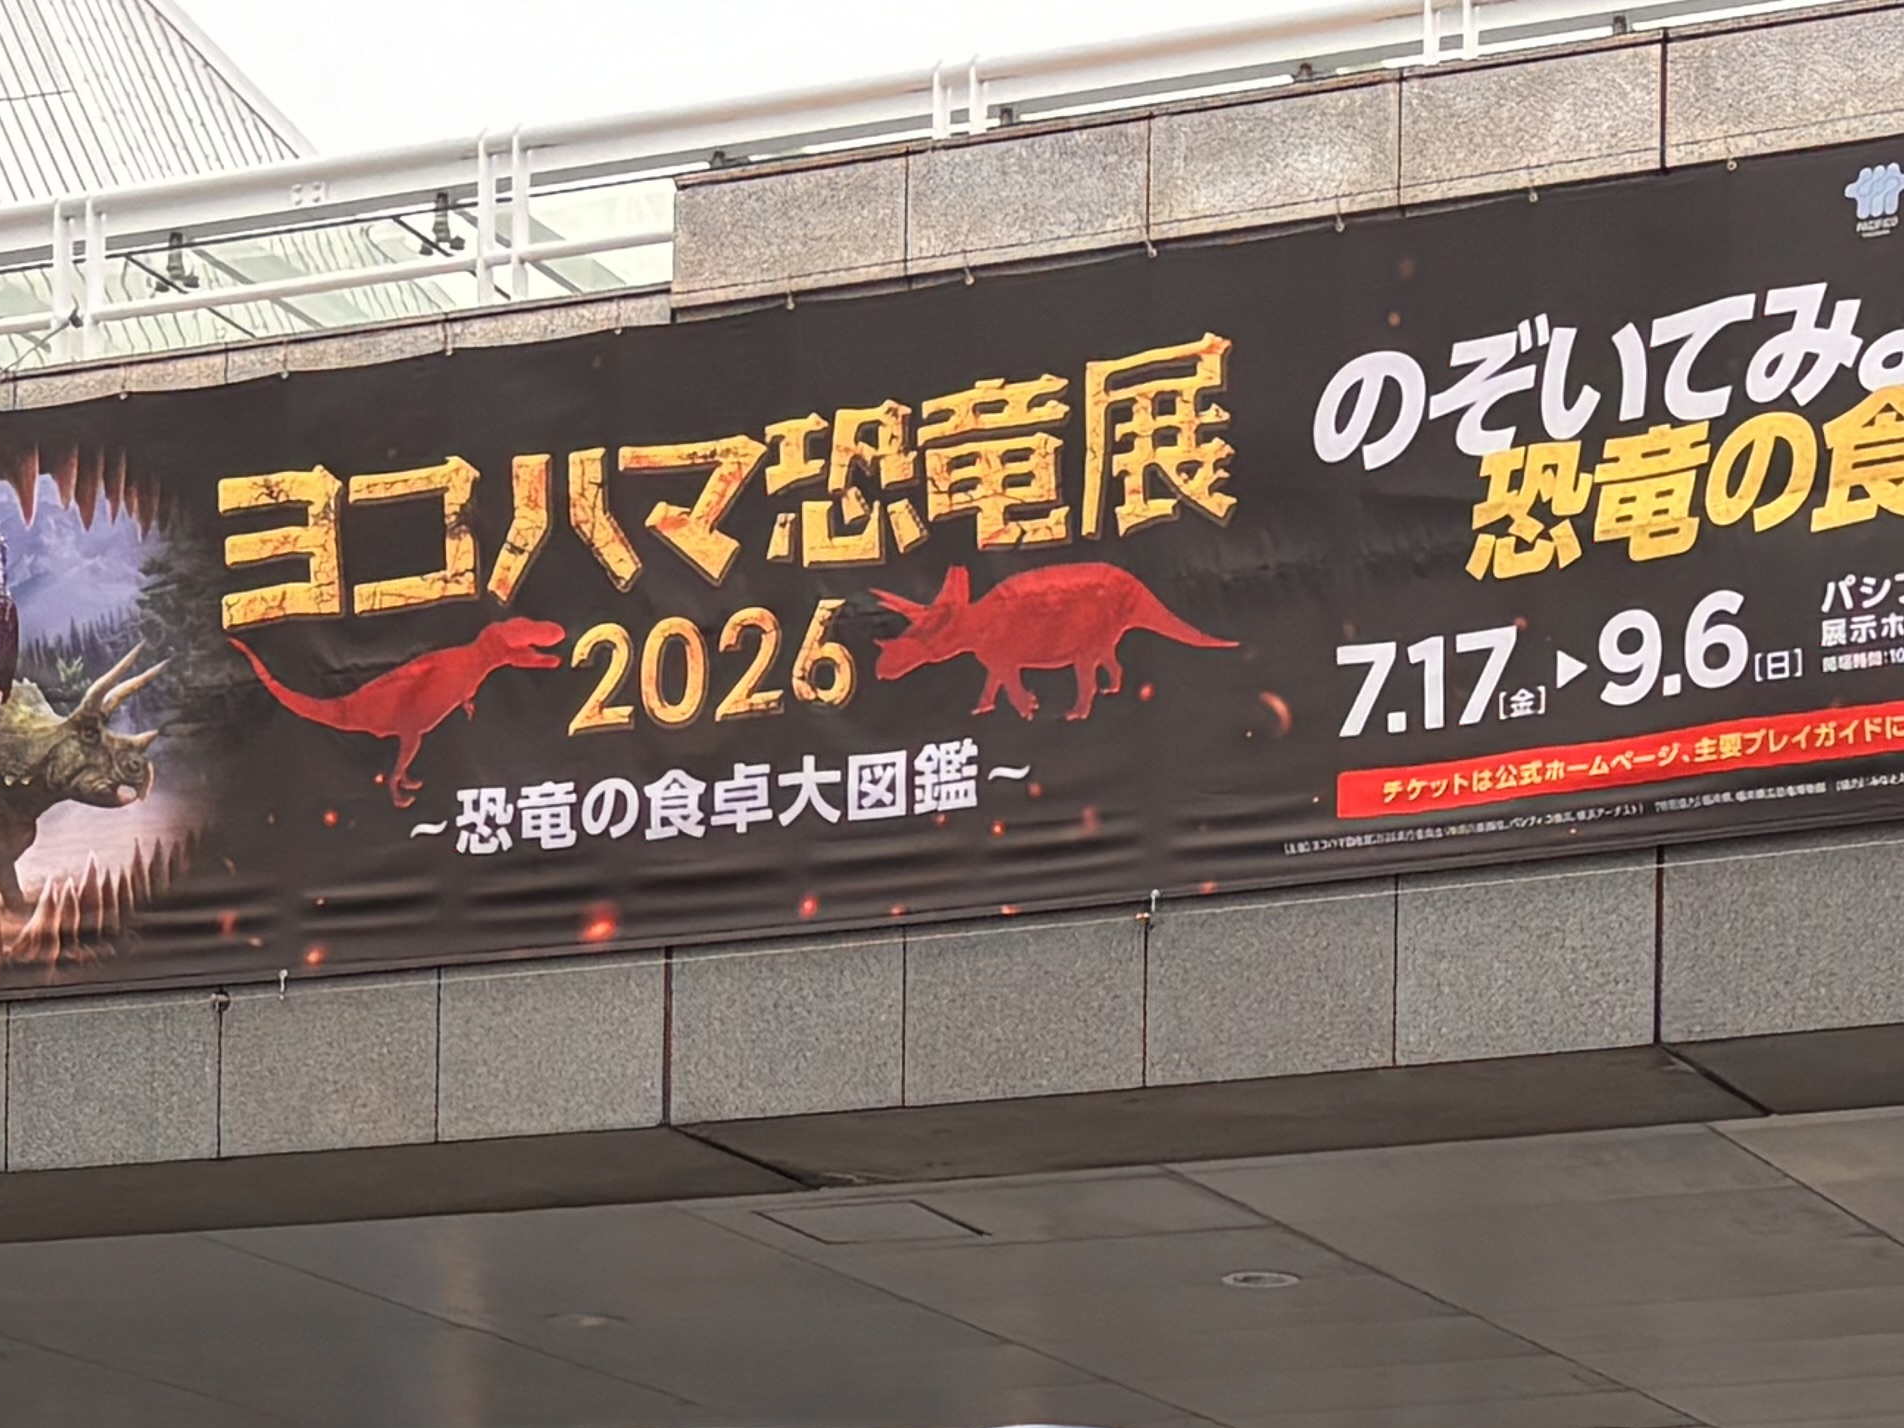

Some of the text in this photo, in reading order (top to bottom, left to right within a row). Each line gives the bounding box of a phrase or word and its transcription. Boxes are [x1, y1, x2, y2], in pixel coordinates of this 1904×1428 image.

[218, 332, 1237, 632] ヨコハマ恐竜展
[568, 598, 856, 737] 2026
[1336, 626, 1518, 737] 7.17
[1598, 590, 1748, 706] 9.6
